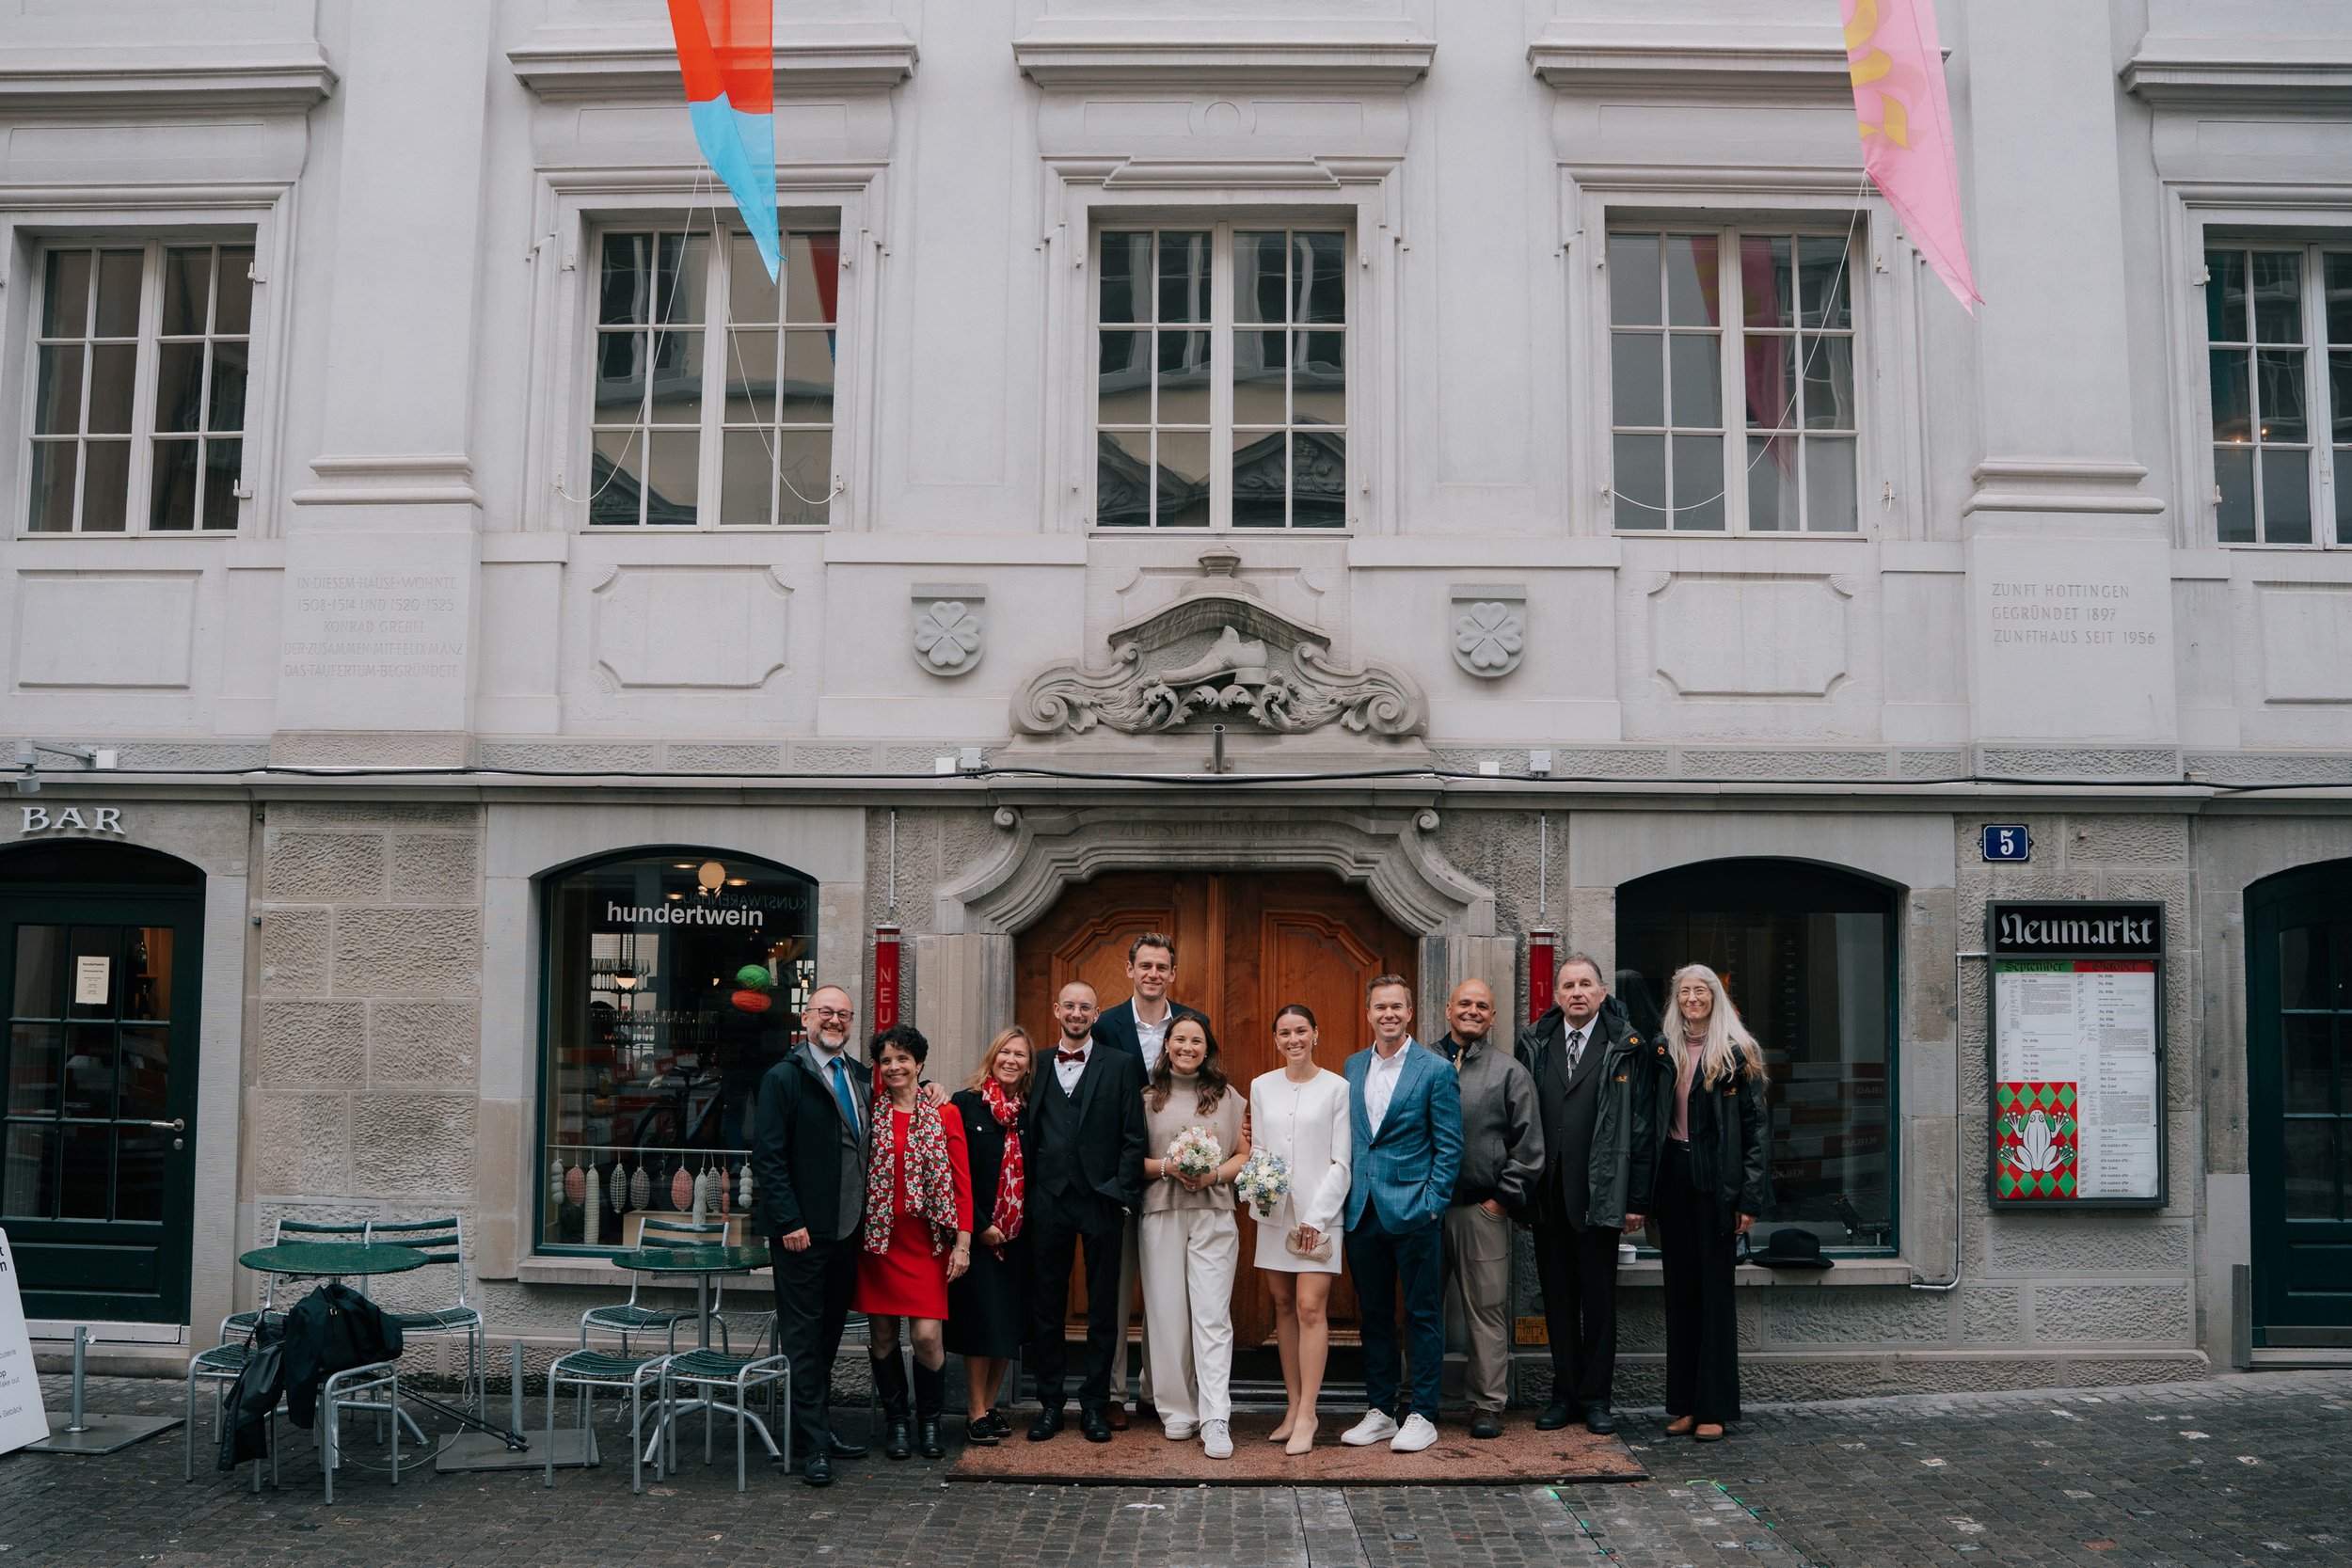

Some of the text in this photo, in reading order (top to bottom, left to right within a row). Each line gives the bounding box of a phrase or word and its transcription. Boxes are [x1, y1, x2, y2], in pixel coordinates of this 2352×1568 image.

[401, 577, 457, 590] WOHNTE
[1992, 583, 2129, 598] ZUNFT HOTTINGEN
[360, 598, 386, 611] UND
[1992, 605, 2116, 621] GEGRÜNDET 1897
[324, 621, 426, 634] KONRAD GREBEL
[1994, 629, 2155, 645] ZUNFTHAUS SEIT 1956
[20, 806, 125, 834] BAR
[1999, 830, 2015, 856] 5
[607, 900, 764, 927] hundertwein
[1999, 912, 2154, 945] Neumarkt
[2005, 961, 2064, 973] September
